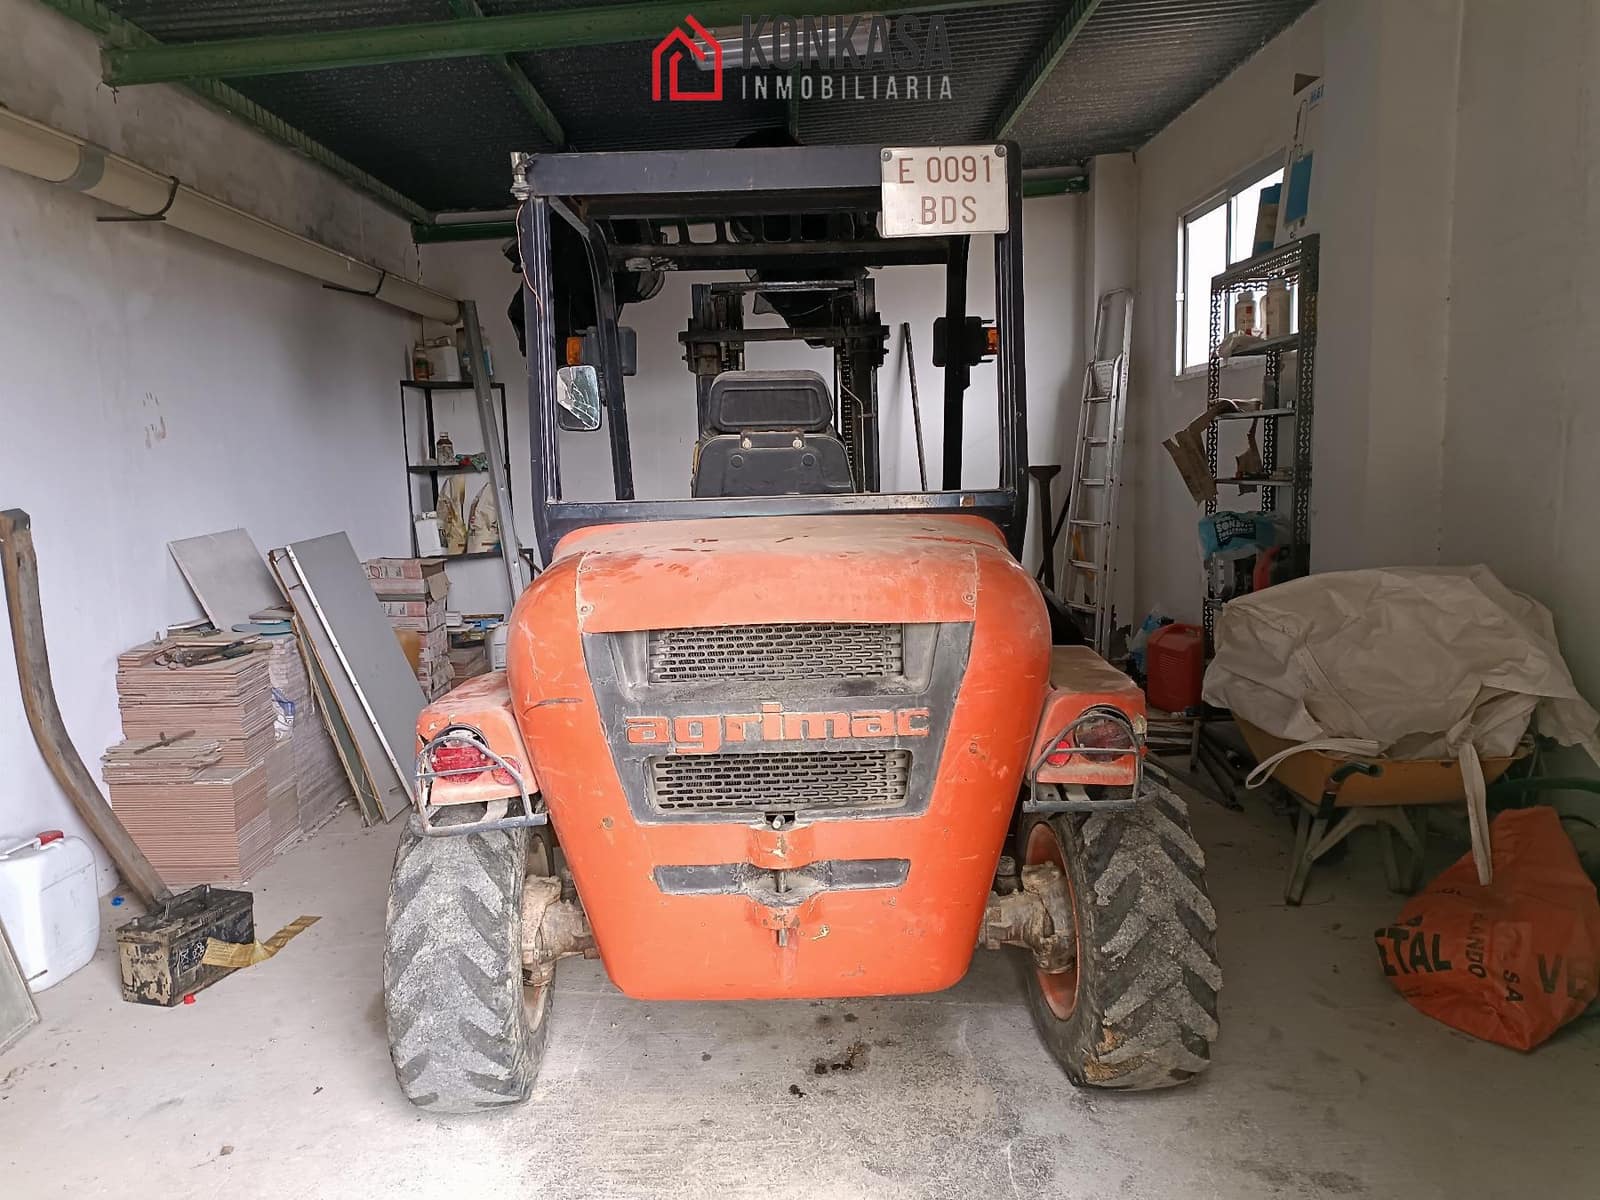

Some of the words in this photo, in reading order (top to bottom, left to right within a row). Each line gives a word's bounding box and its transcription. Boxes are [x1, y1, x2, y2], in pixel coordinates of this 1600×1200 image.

[898, 157, 914, 184] E
[926, 155, 992, 184] 0091
[921, 196, 977, 226] BDS
[625, 703, 929, 753] agrimac
